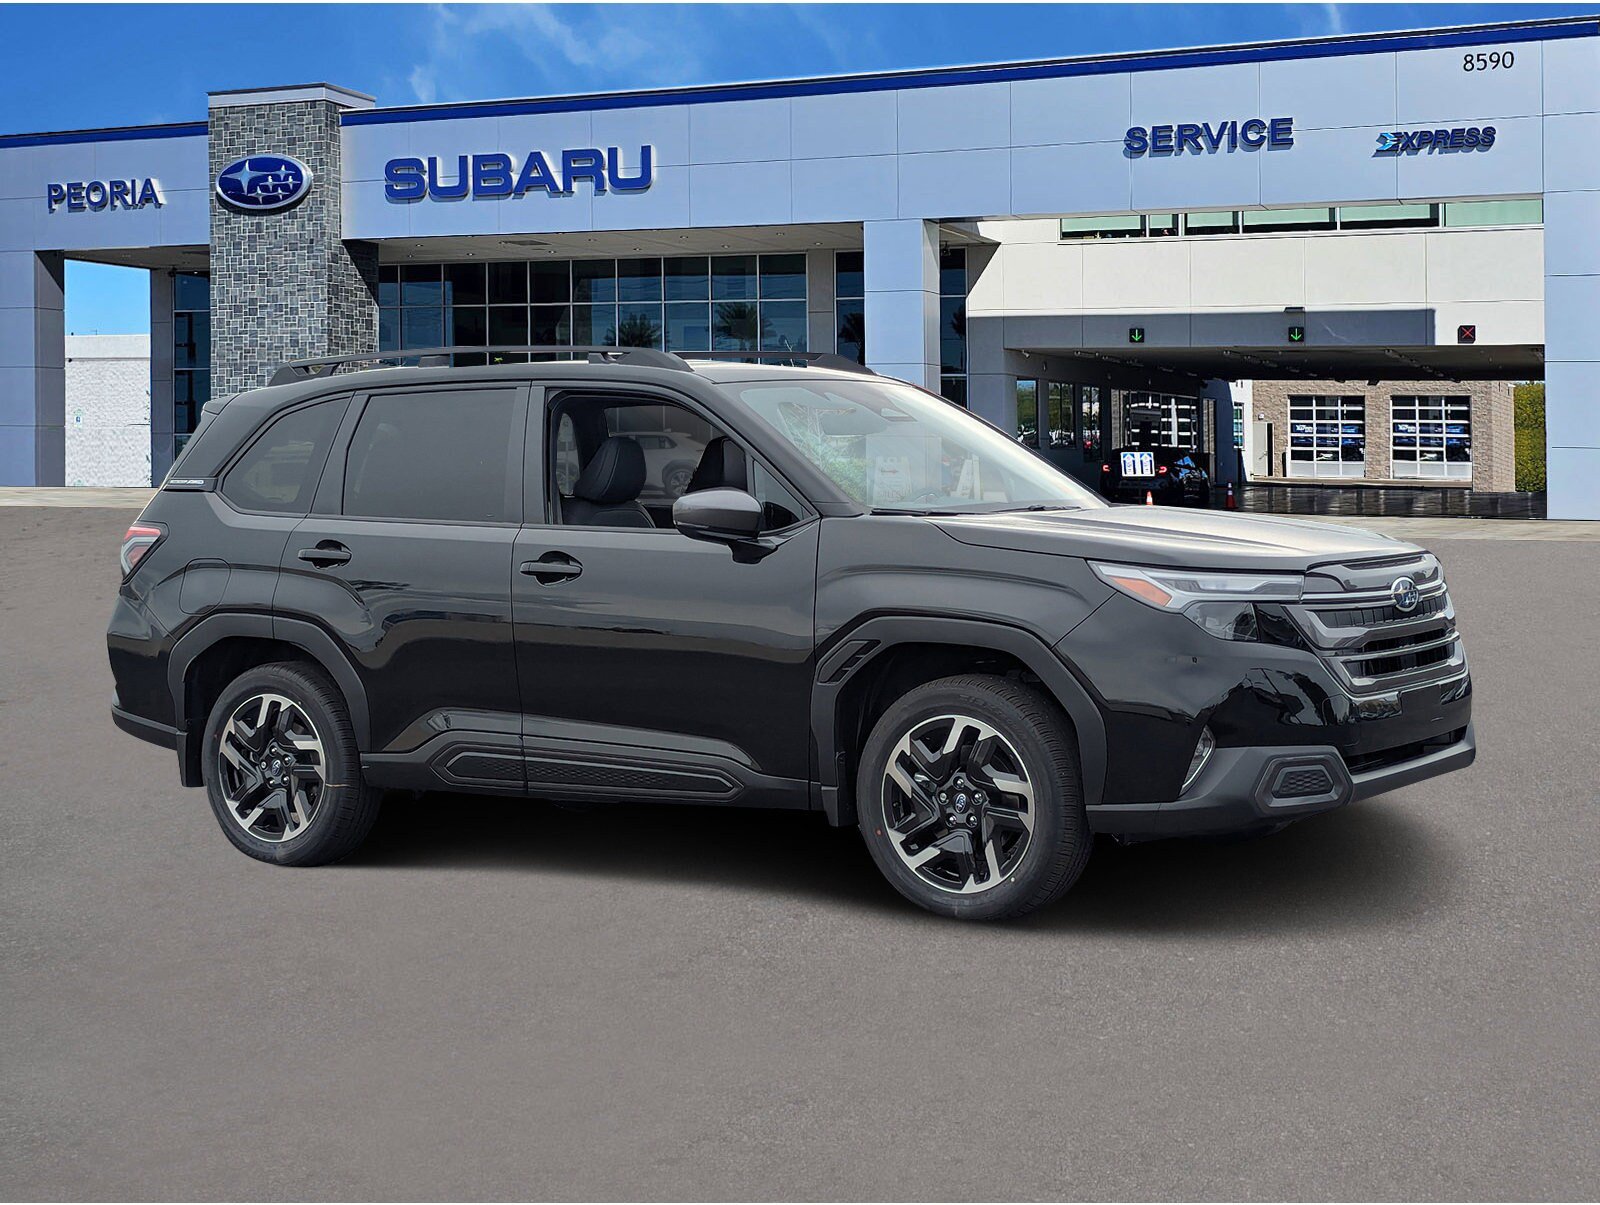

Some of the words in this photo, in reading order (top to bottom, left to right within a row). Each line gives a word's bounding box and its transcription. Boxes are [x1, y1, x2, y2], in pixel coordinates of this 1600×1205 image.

[1463, 51, 1515, 72] 8590
[1124, 117, 1294, 153] SERVICE
[1375, 126, 1497, 152] EXPRESS
[384, 145, 652, 202] SUBARU
[47, 178, 162, 211] PEORIA
